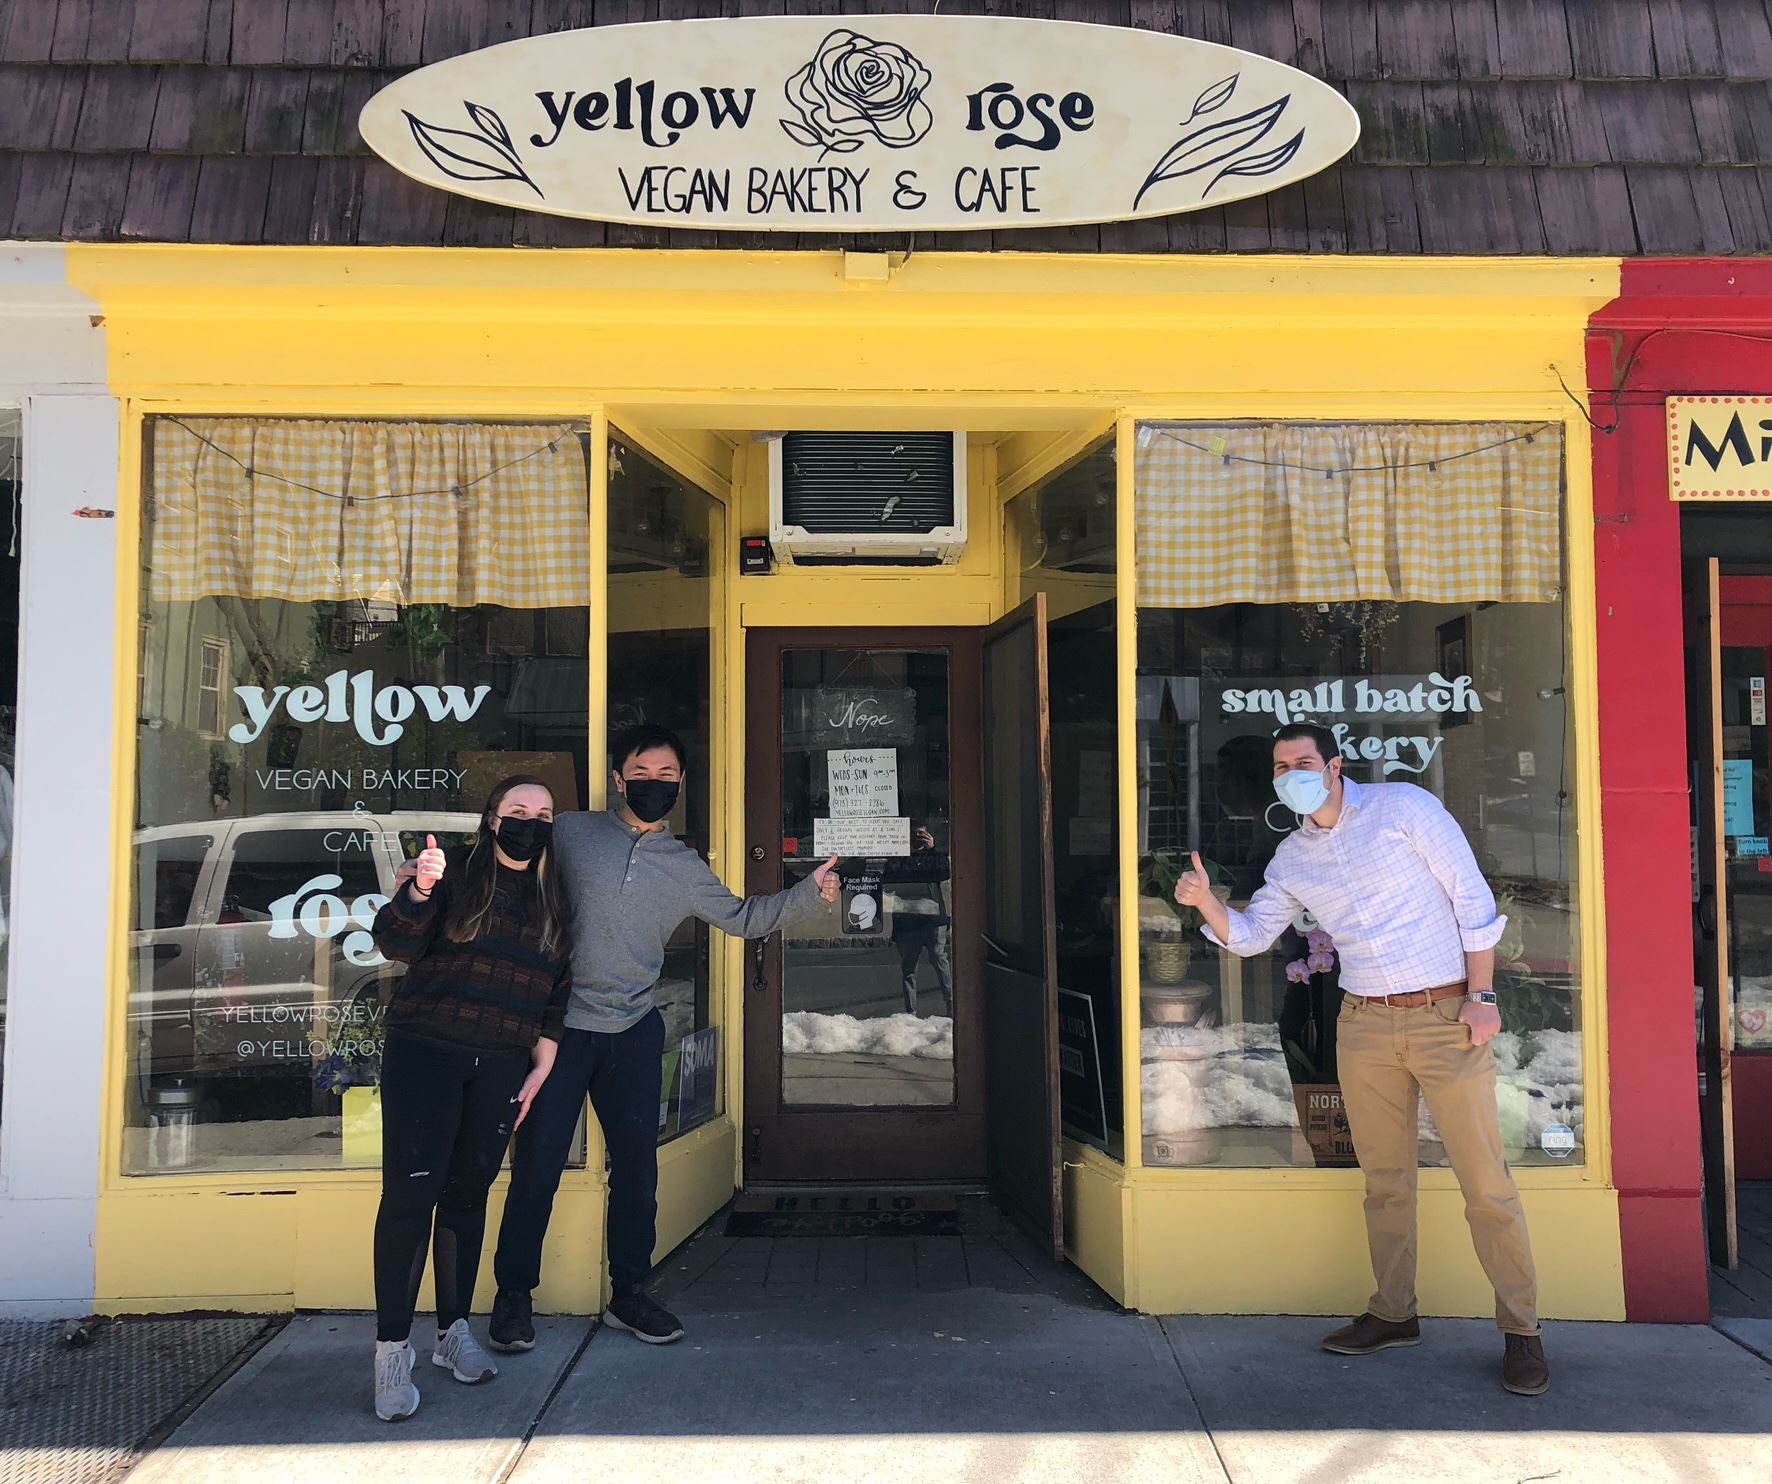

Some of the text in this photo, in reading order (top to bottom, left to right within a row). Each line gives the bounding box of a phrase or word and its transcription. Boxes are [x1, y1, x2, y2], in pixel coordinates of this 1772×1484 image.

[529, 76, 1095, 151] yellow rose
[617, 165, 1042, 214] VEGAN BAKERY & CAFE
[228, 669, 492, 747] yellow
[1221, 671, 1483, 724] small batch
[829, 698, 894, 734] Nope
[1273, 720, 1444, 776] kery
[843, 751, 876, 767] hours
[255, 769, 468, 790] VEGAN BAKERY
[352, 801, 367, 820] &
[323, 831, 398, 853] CAFE
[843, 875, 881, 884] Face Mask
[845, 882, 879, 893] Required
[268, 873, 393, 967] ros
[237, 1040, 385, 1058] @YELLOWROS
[1309, 1094, 1345, 1109] NOR
[774, 1195, 916, 1211] HELLO
